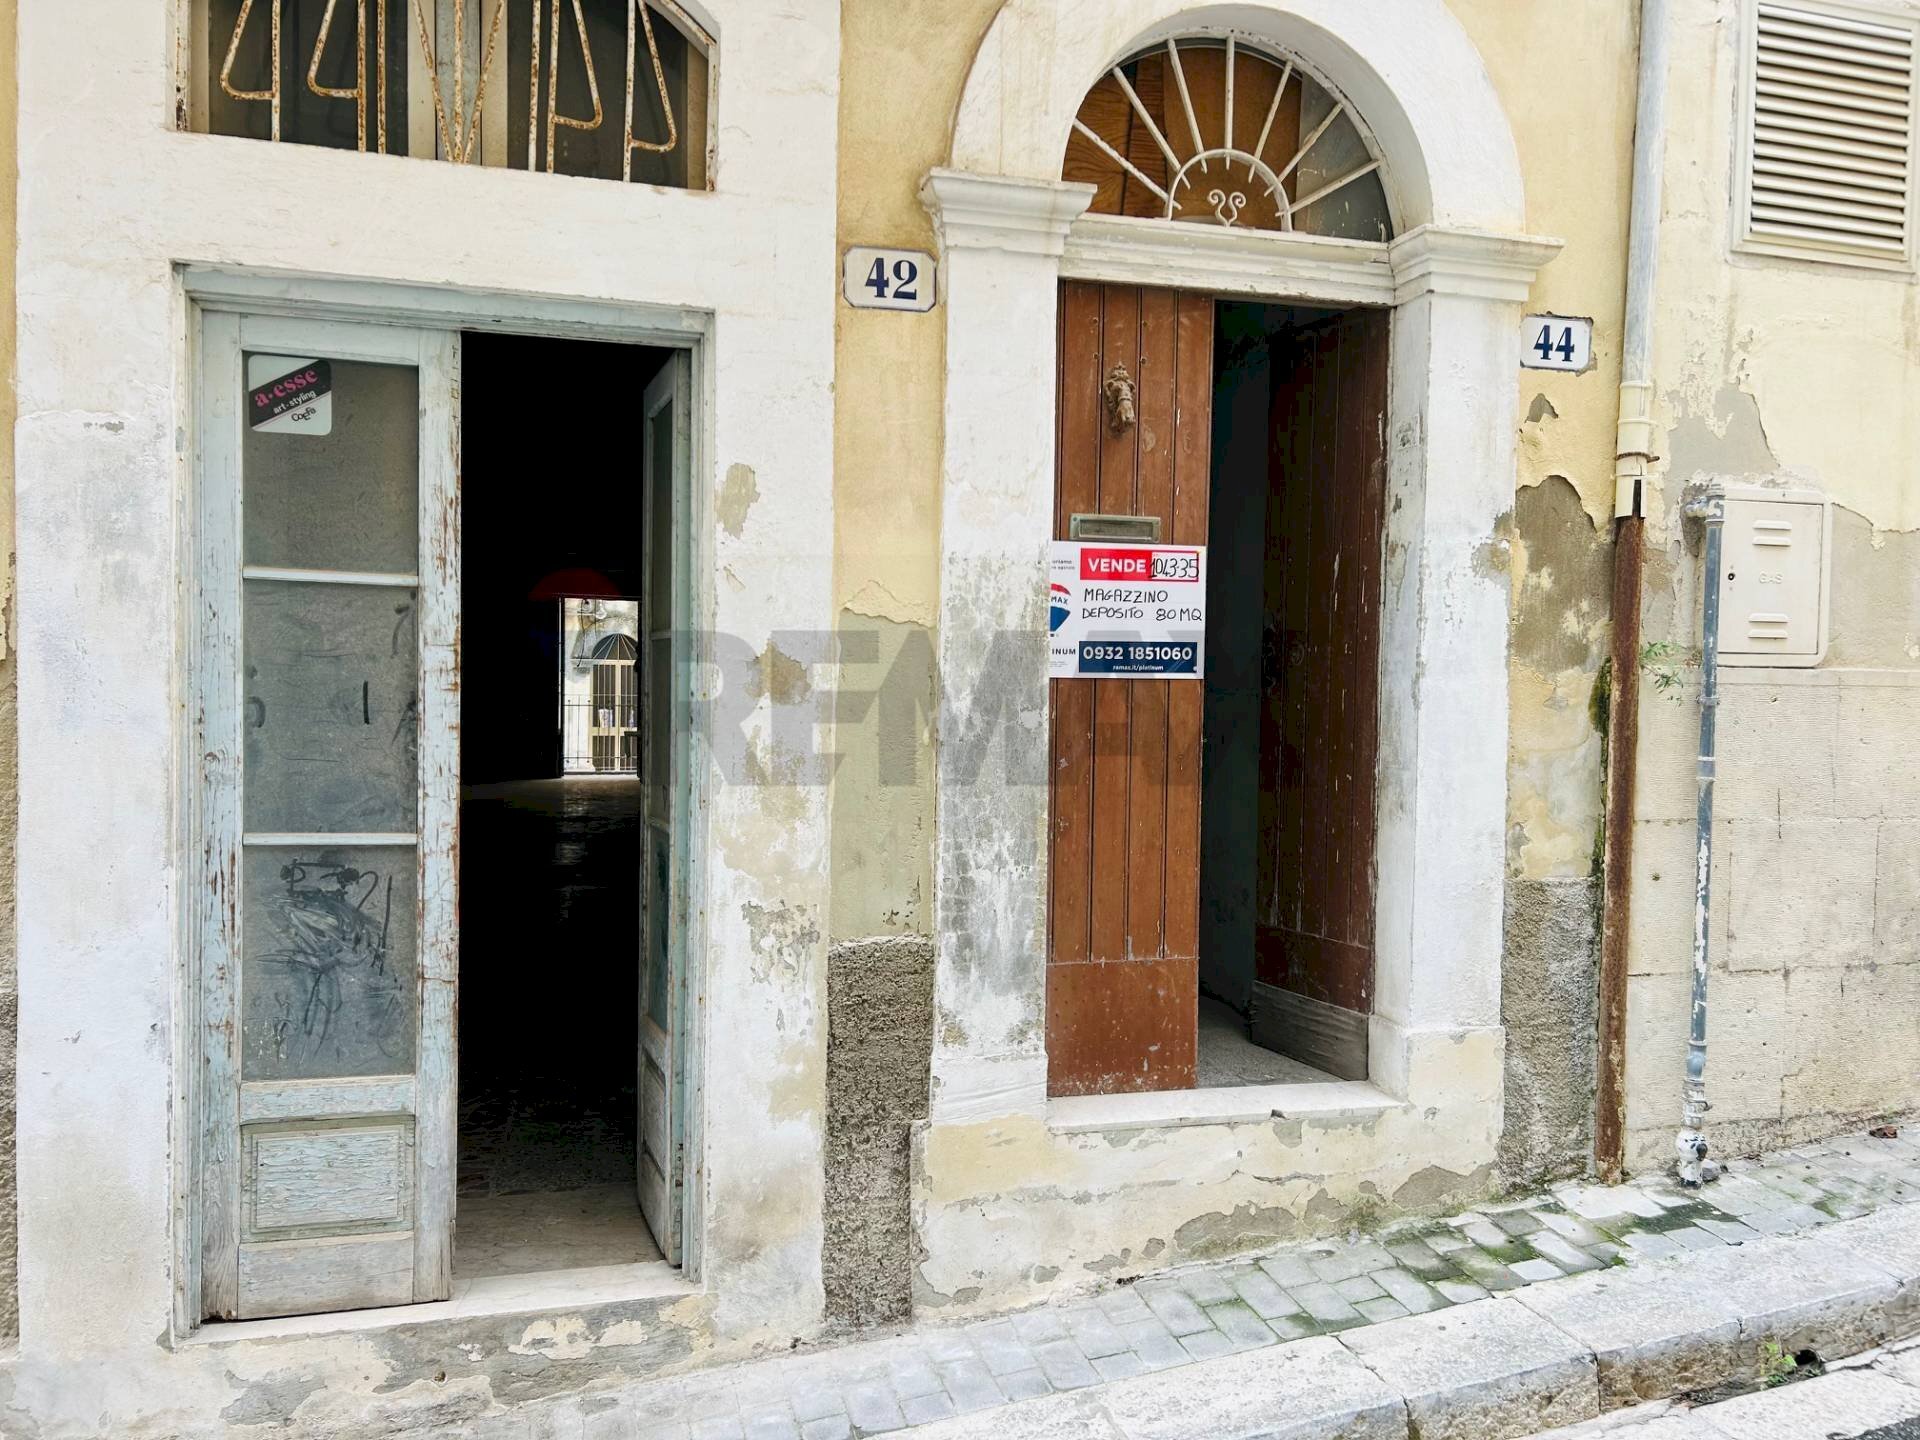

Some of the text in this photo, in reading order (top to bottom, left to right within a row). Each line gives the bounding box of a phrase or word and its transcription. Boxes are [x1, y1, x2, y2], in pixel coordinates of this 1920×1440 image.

[865, 257, 918, 301] 42
[1533, 324, 1575, 362] 44
[1088, 558, 1146, 573] VENDE
[1758, 571, 1783, 585] GAS
[1084, 588, 1168, 603] MAGAZZINO
[1082, 606, 1202, 622] DEPOSITO 80 MQ
[1083, 646, 1193, 661] 0932 1851060
